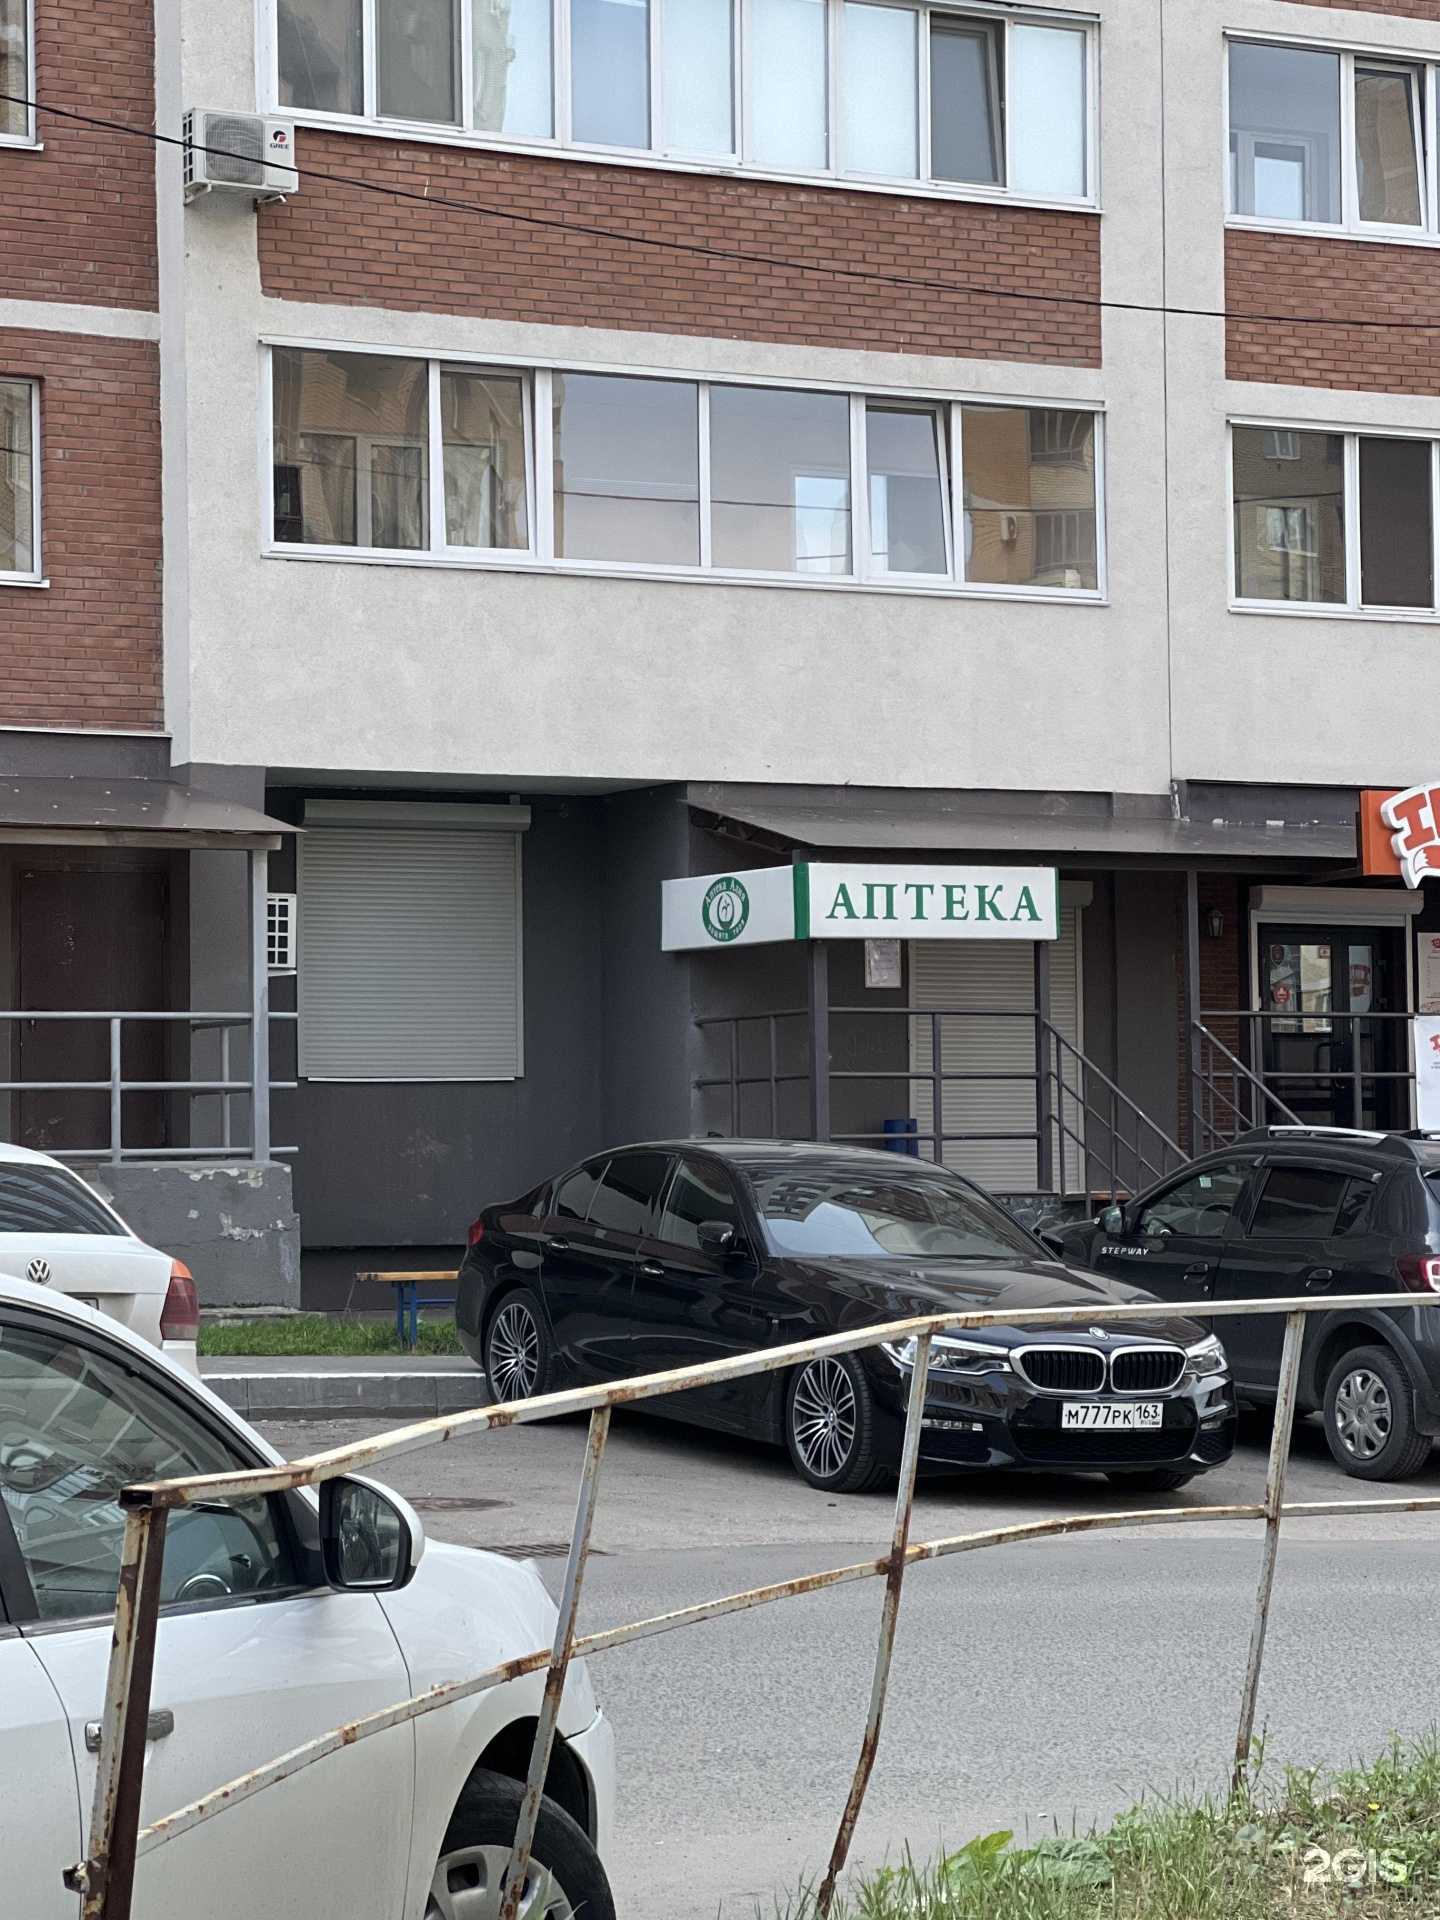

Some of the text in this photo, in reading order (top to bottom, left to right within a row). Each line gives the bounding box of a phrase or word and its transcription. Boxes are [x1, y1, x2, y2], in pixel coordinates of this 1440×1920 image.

[825, 883, 1042, 921] АПТЕКА
[1101, 1246, 1149, 1256] STEPWAY
[1136, 1404, 1158, 1419] 163
